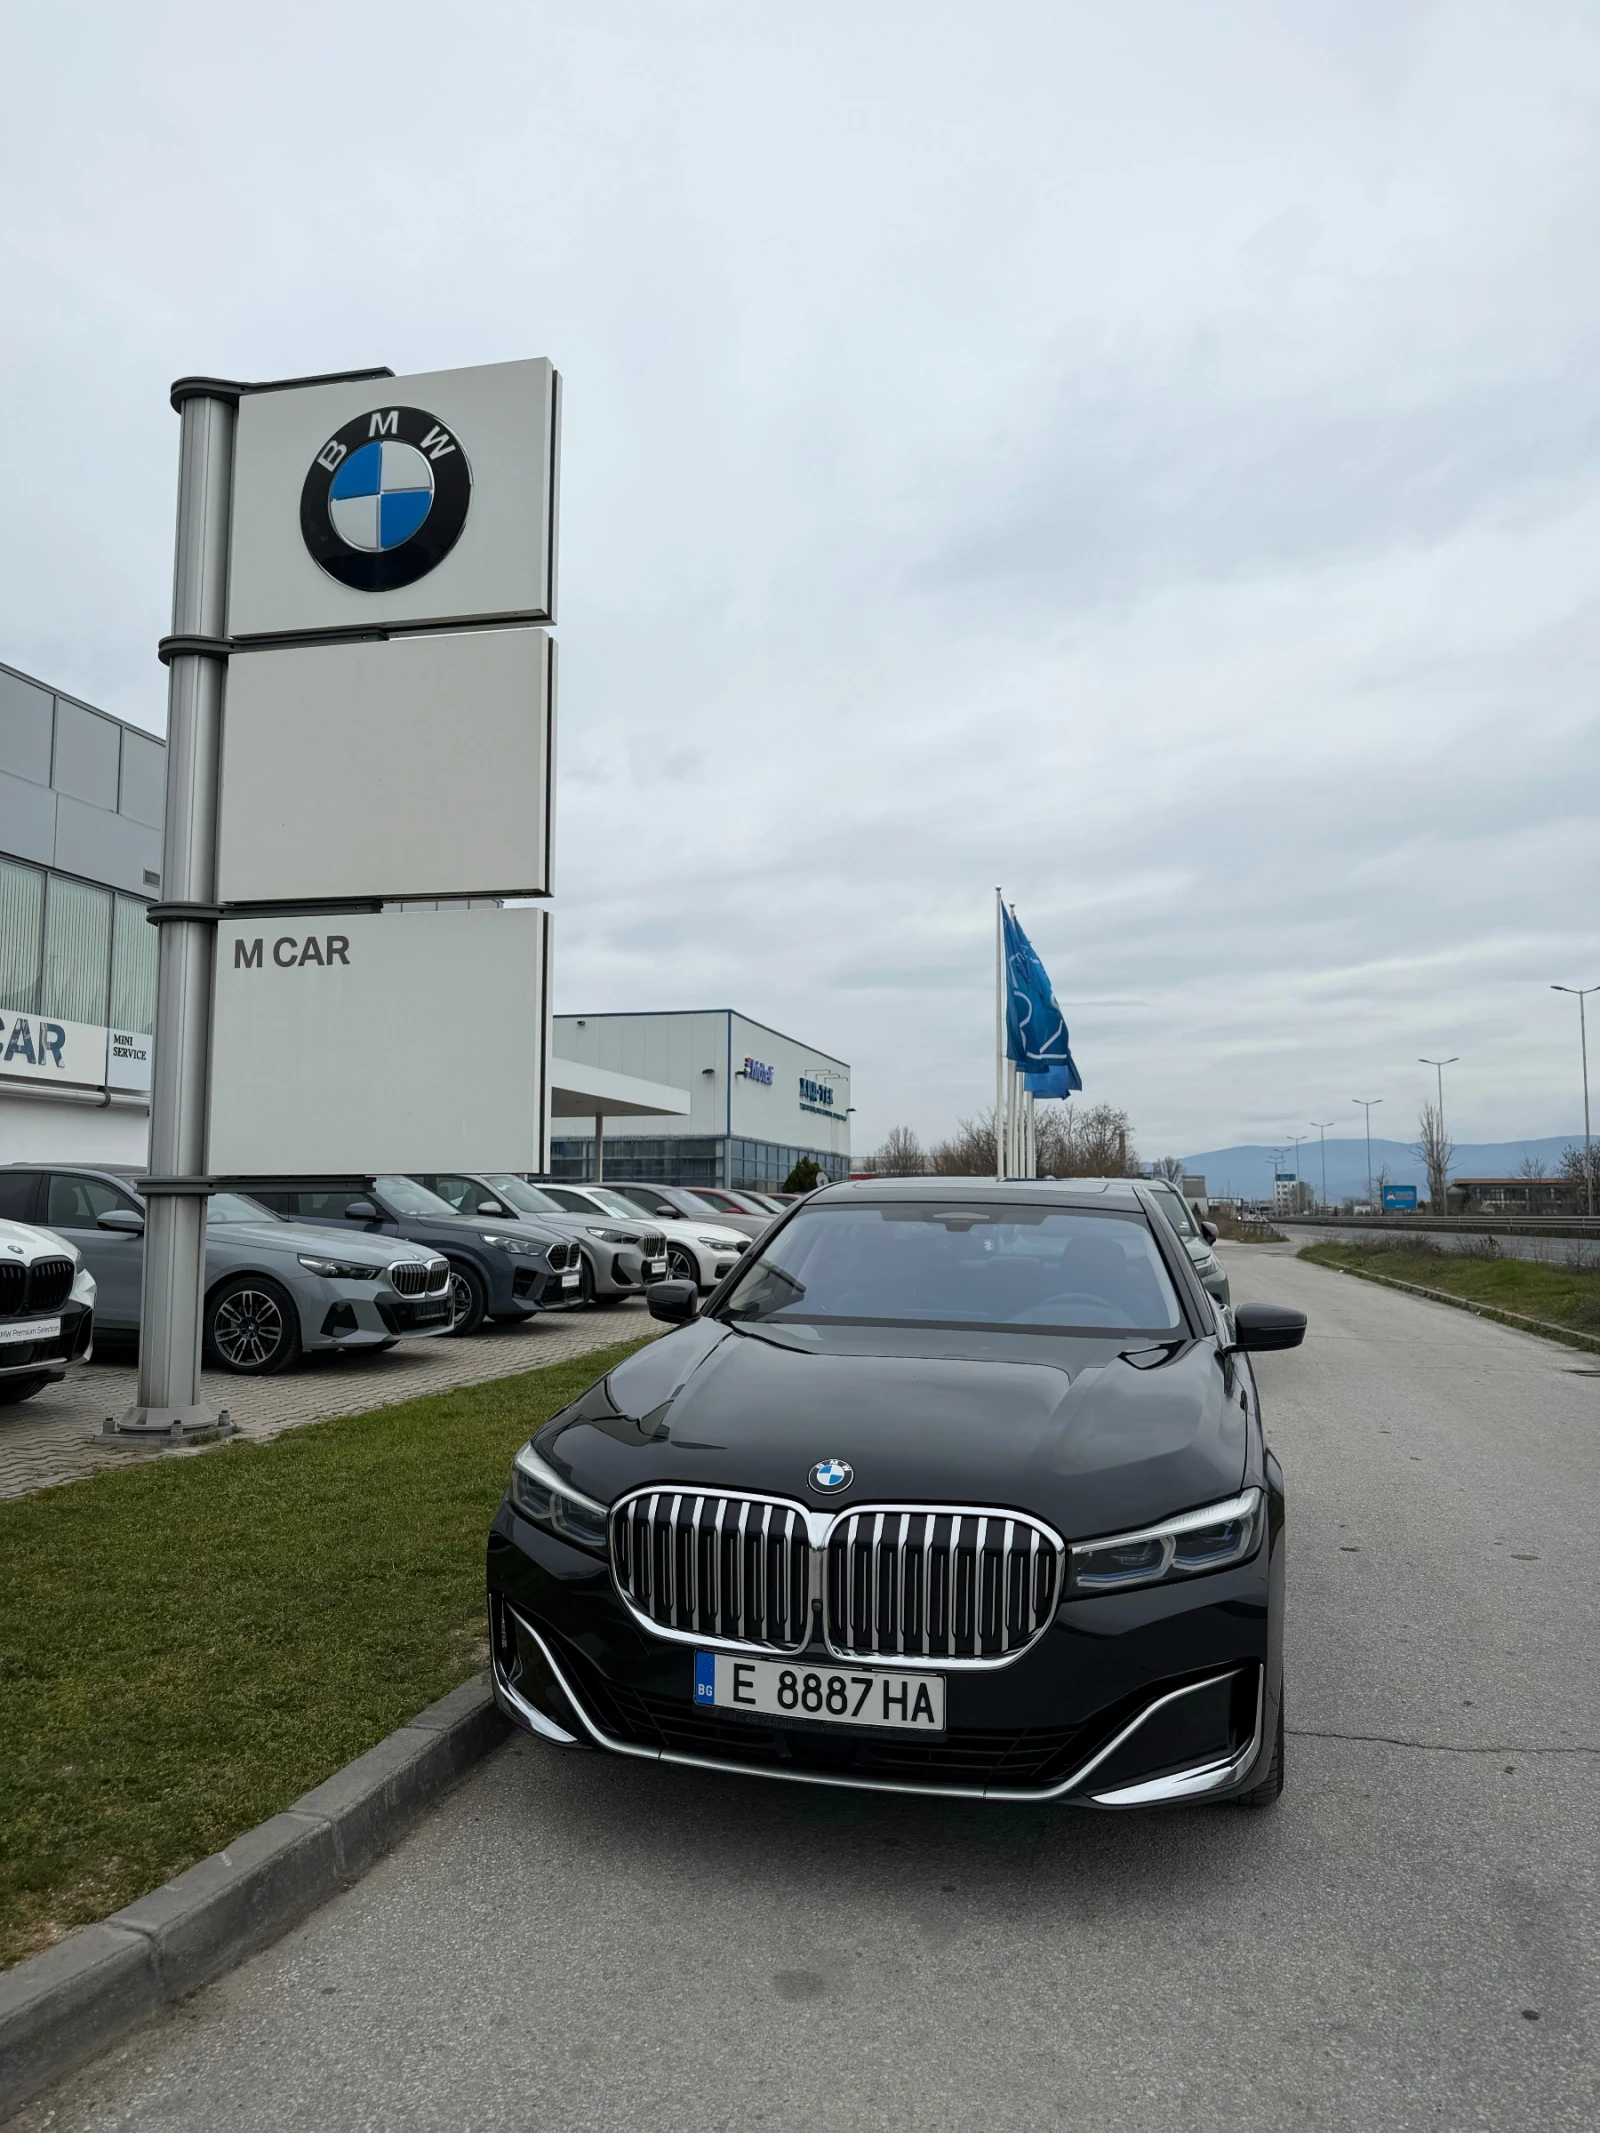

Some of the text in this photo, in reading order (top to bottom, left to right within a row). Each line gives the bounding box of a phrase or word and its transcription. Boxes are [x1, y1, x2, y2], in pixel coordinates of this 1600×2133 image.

[317, 410, 456, 473] BMW
[234, 935, 351, 969] M CAR
[0, 1016, 66, 1068] AR
[113, 1033, 133, 1046] MINI
[113, 1046, 147, 1060] SERVICE
[12, 1328, 37, 1336] Premium
[37, 1325, 59, 1334] Selection
[815, 1460, 852, 1471] BMW
[698, 1683, 713, 1697] BG
[733, 1662, 935, 1723] E 8887 HA
